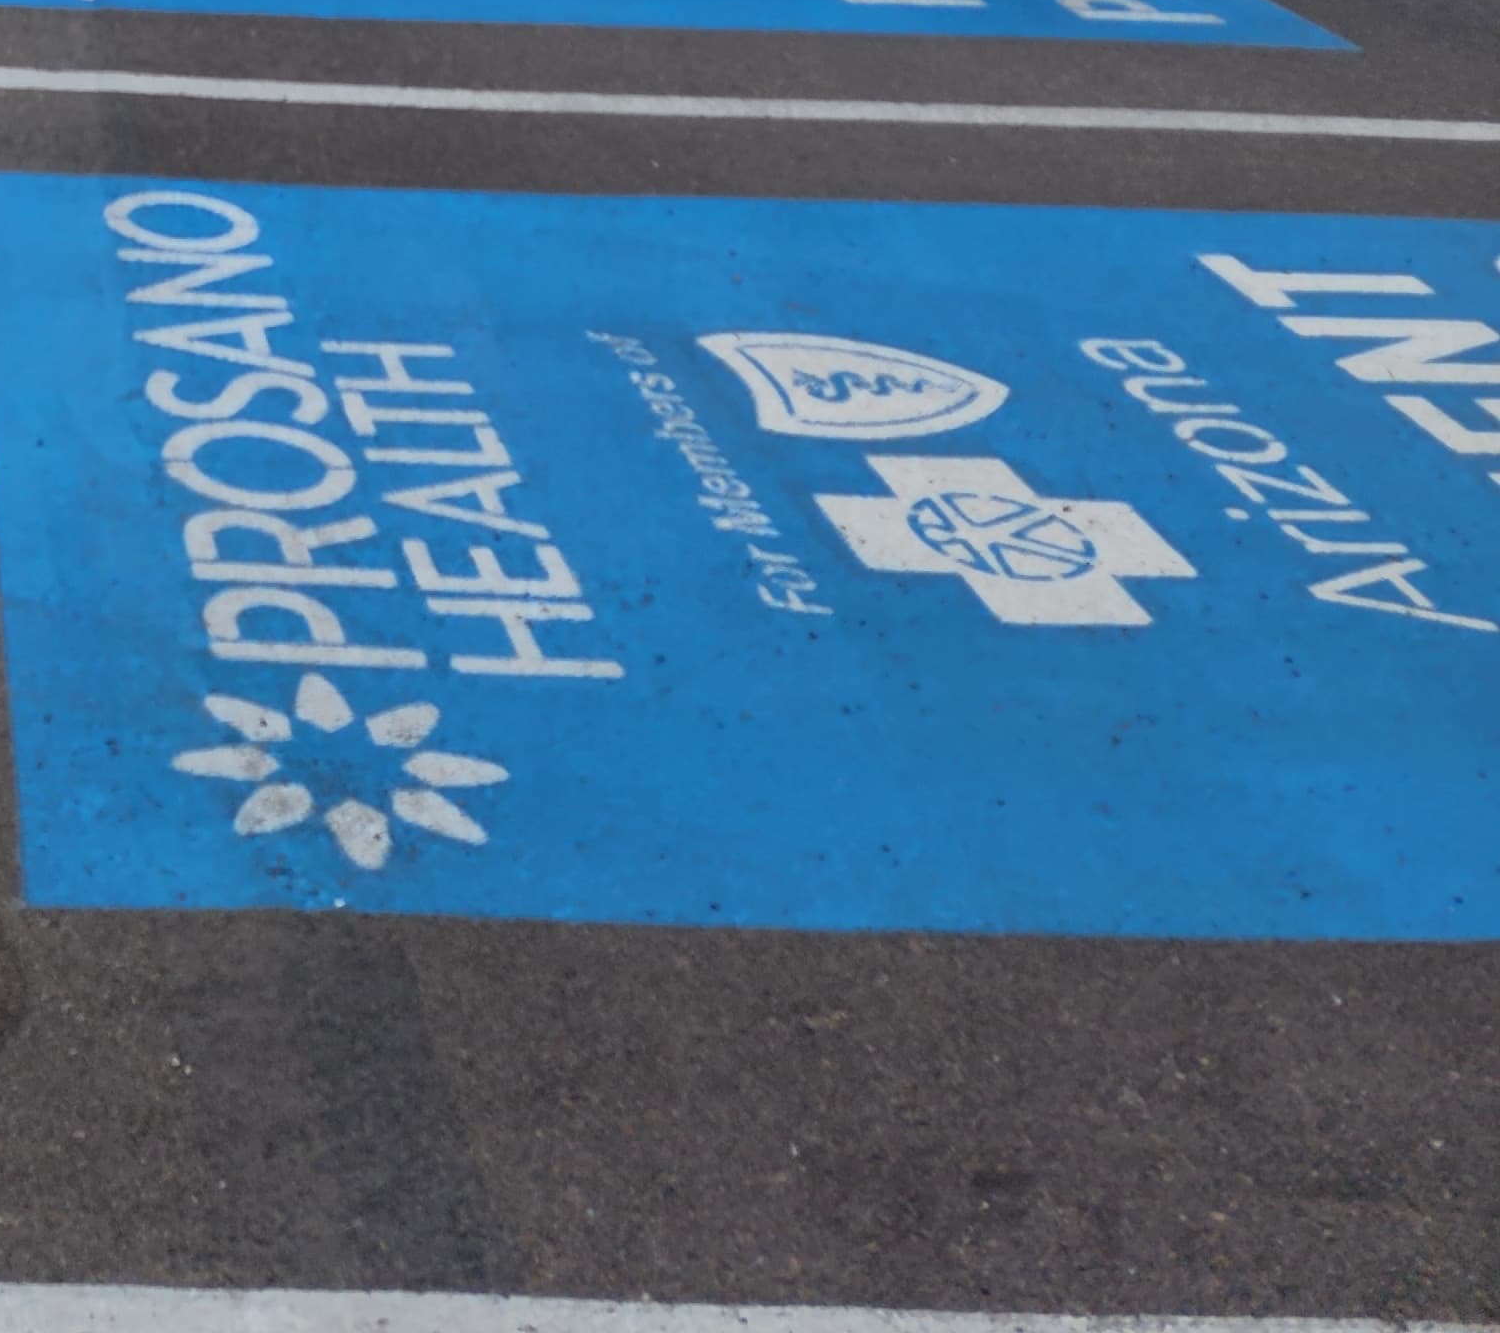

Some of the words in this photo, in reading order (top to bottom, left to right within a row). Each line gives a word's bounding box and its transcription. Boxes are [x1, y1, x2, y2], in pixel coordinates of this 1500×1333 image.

[103, 190, 428, 669] PROSANO
[585, 329, 658, 367] of
[628, 369, 782, 538] Members
[319, 340, 625, 679] HEALTH
[747, 542, 835, 616] For
[1078, 336, 1499, 632] Arizona
